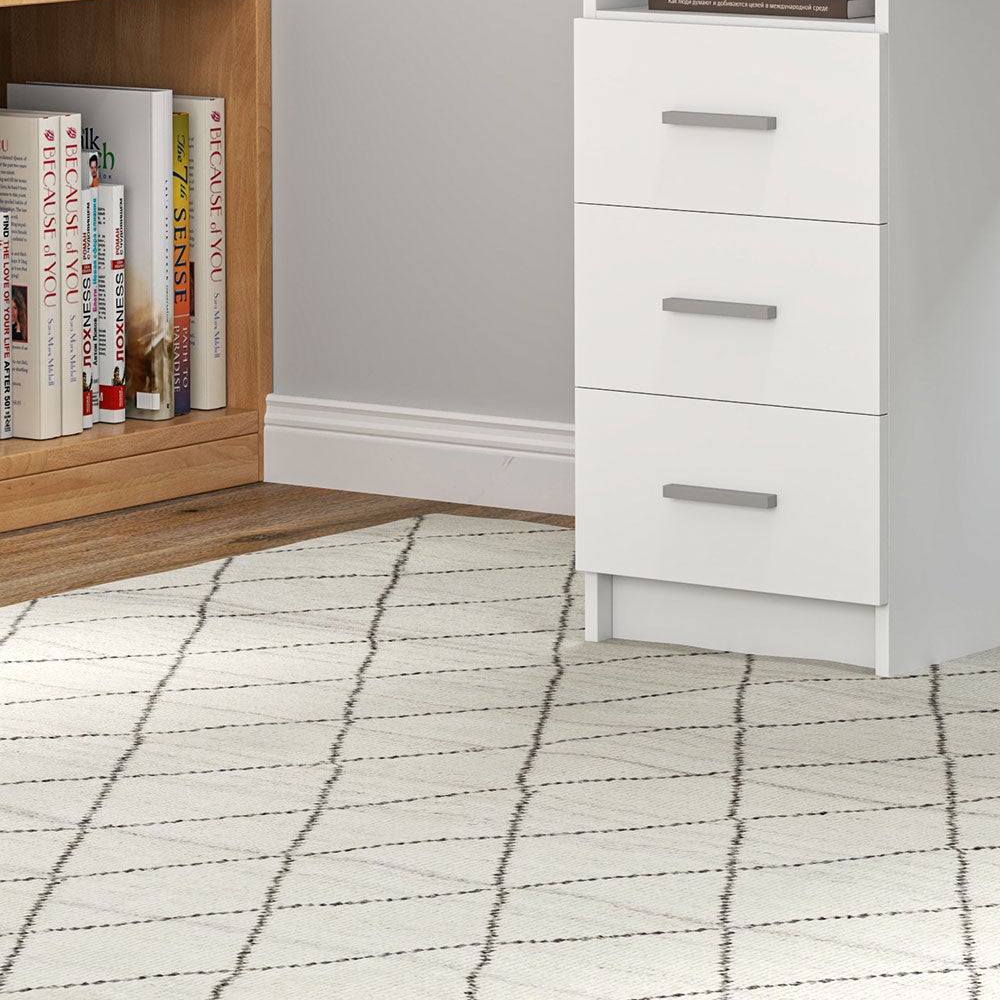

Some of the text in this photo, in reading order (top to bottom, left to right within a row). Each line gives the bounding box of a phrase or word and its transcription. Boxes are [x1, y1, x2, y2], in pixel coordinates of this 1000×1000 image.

[43, 147, 57, 308] BECAUSE of YOU
[65, 144, 79, 305] BECAUSE of YOU
[173, 134, 188, 304] The 7th SENSE
[210, 127, 223, 283] BECAUSE of YOU
[3, 290, 10, 303] OF
[183, 369, 188, 388] TO
